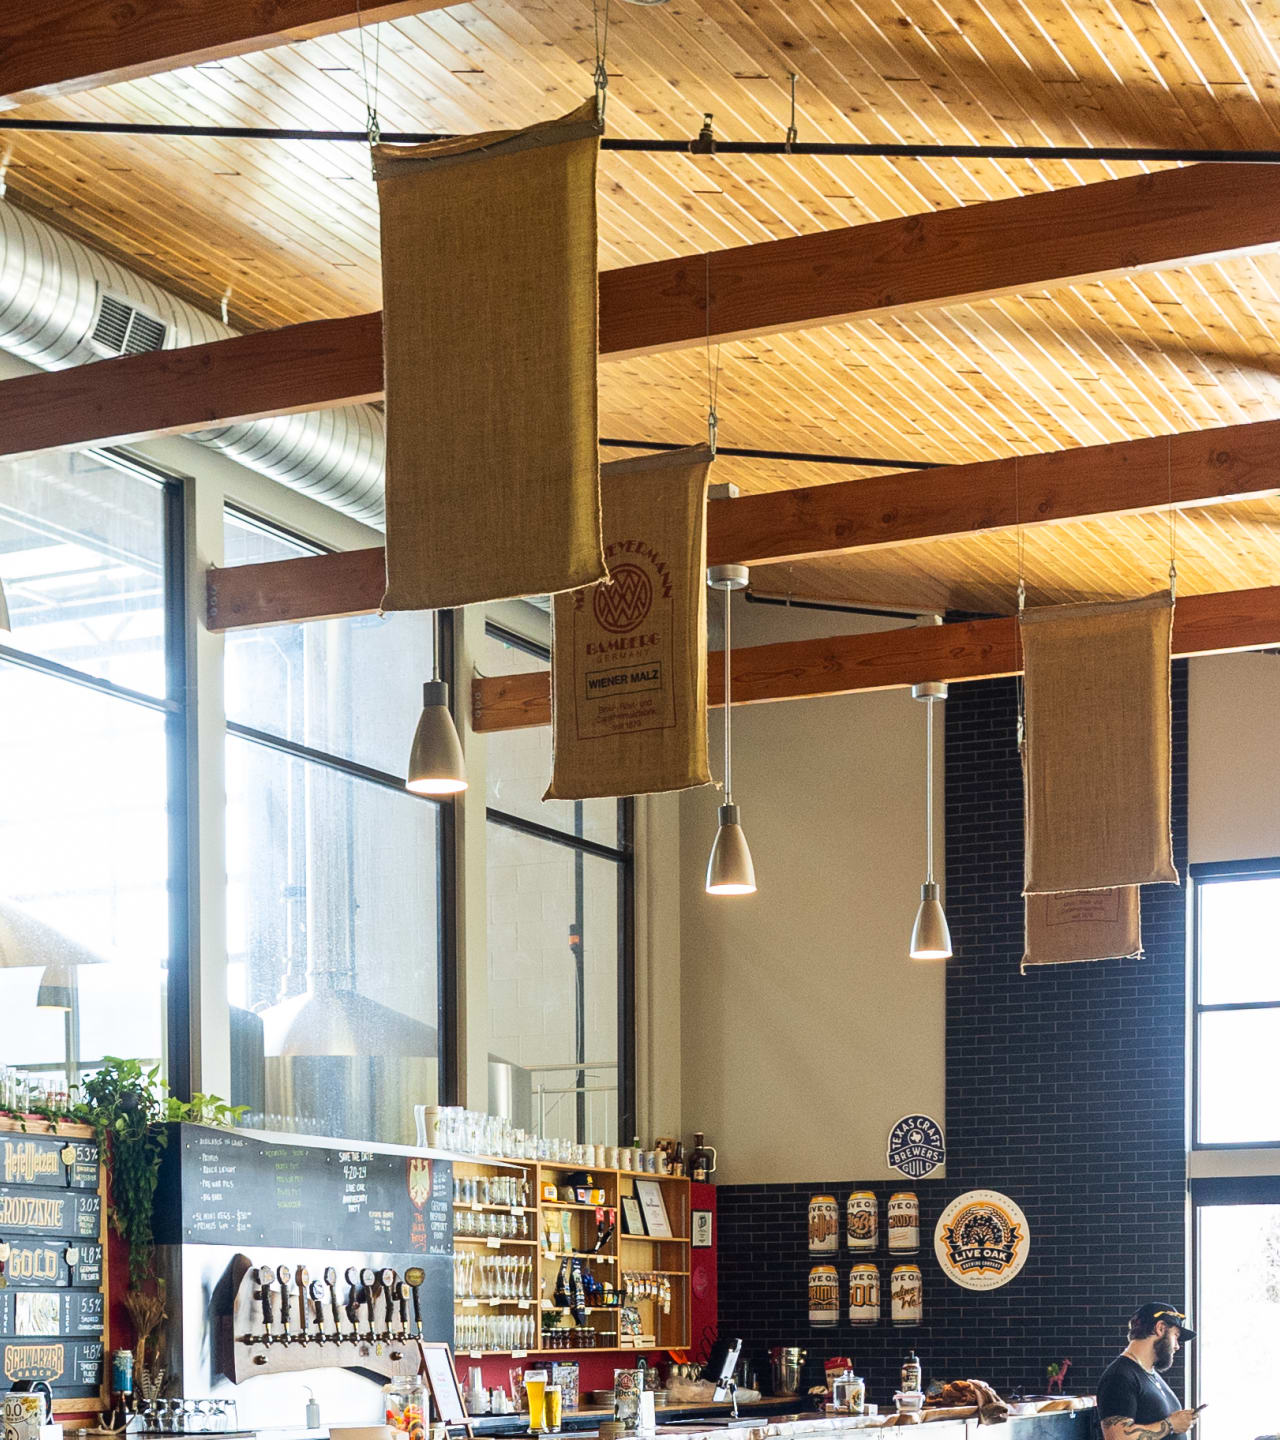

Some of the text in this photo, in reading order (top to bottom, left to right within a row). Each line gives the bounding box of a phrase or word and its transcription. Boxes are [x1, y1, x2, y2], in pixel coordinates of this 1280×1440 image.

[604, 540, 673, 599] EYERMANN
[586, 632, 662, 656] BAMBERG
[588, 669, 659, 690] WIENER MALZ
[892, 1118, 940, 1149] TEXAS CRAFT
[76, 1146, 98, 1161] 5.3%
[893, 1146, 939, 1163] BREWERS
[902, 1159, 933, 1176] GUILD
[80, 1198, 100, 1212] 3.0%
[81, 1246, 102, 1264] 4.8%
[955, 1249, 1007, 1261] LIVE OAK
[9, 1248, 58, 1281] GOLD
[6, 1346, 63, 1374] SCHWARZER
[17, 1369, 52, 1377] RAUCH
